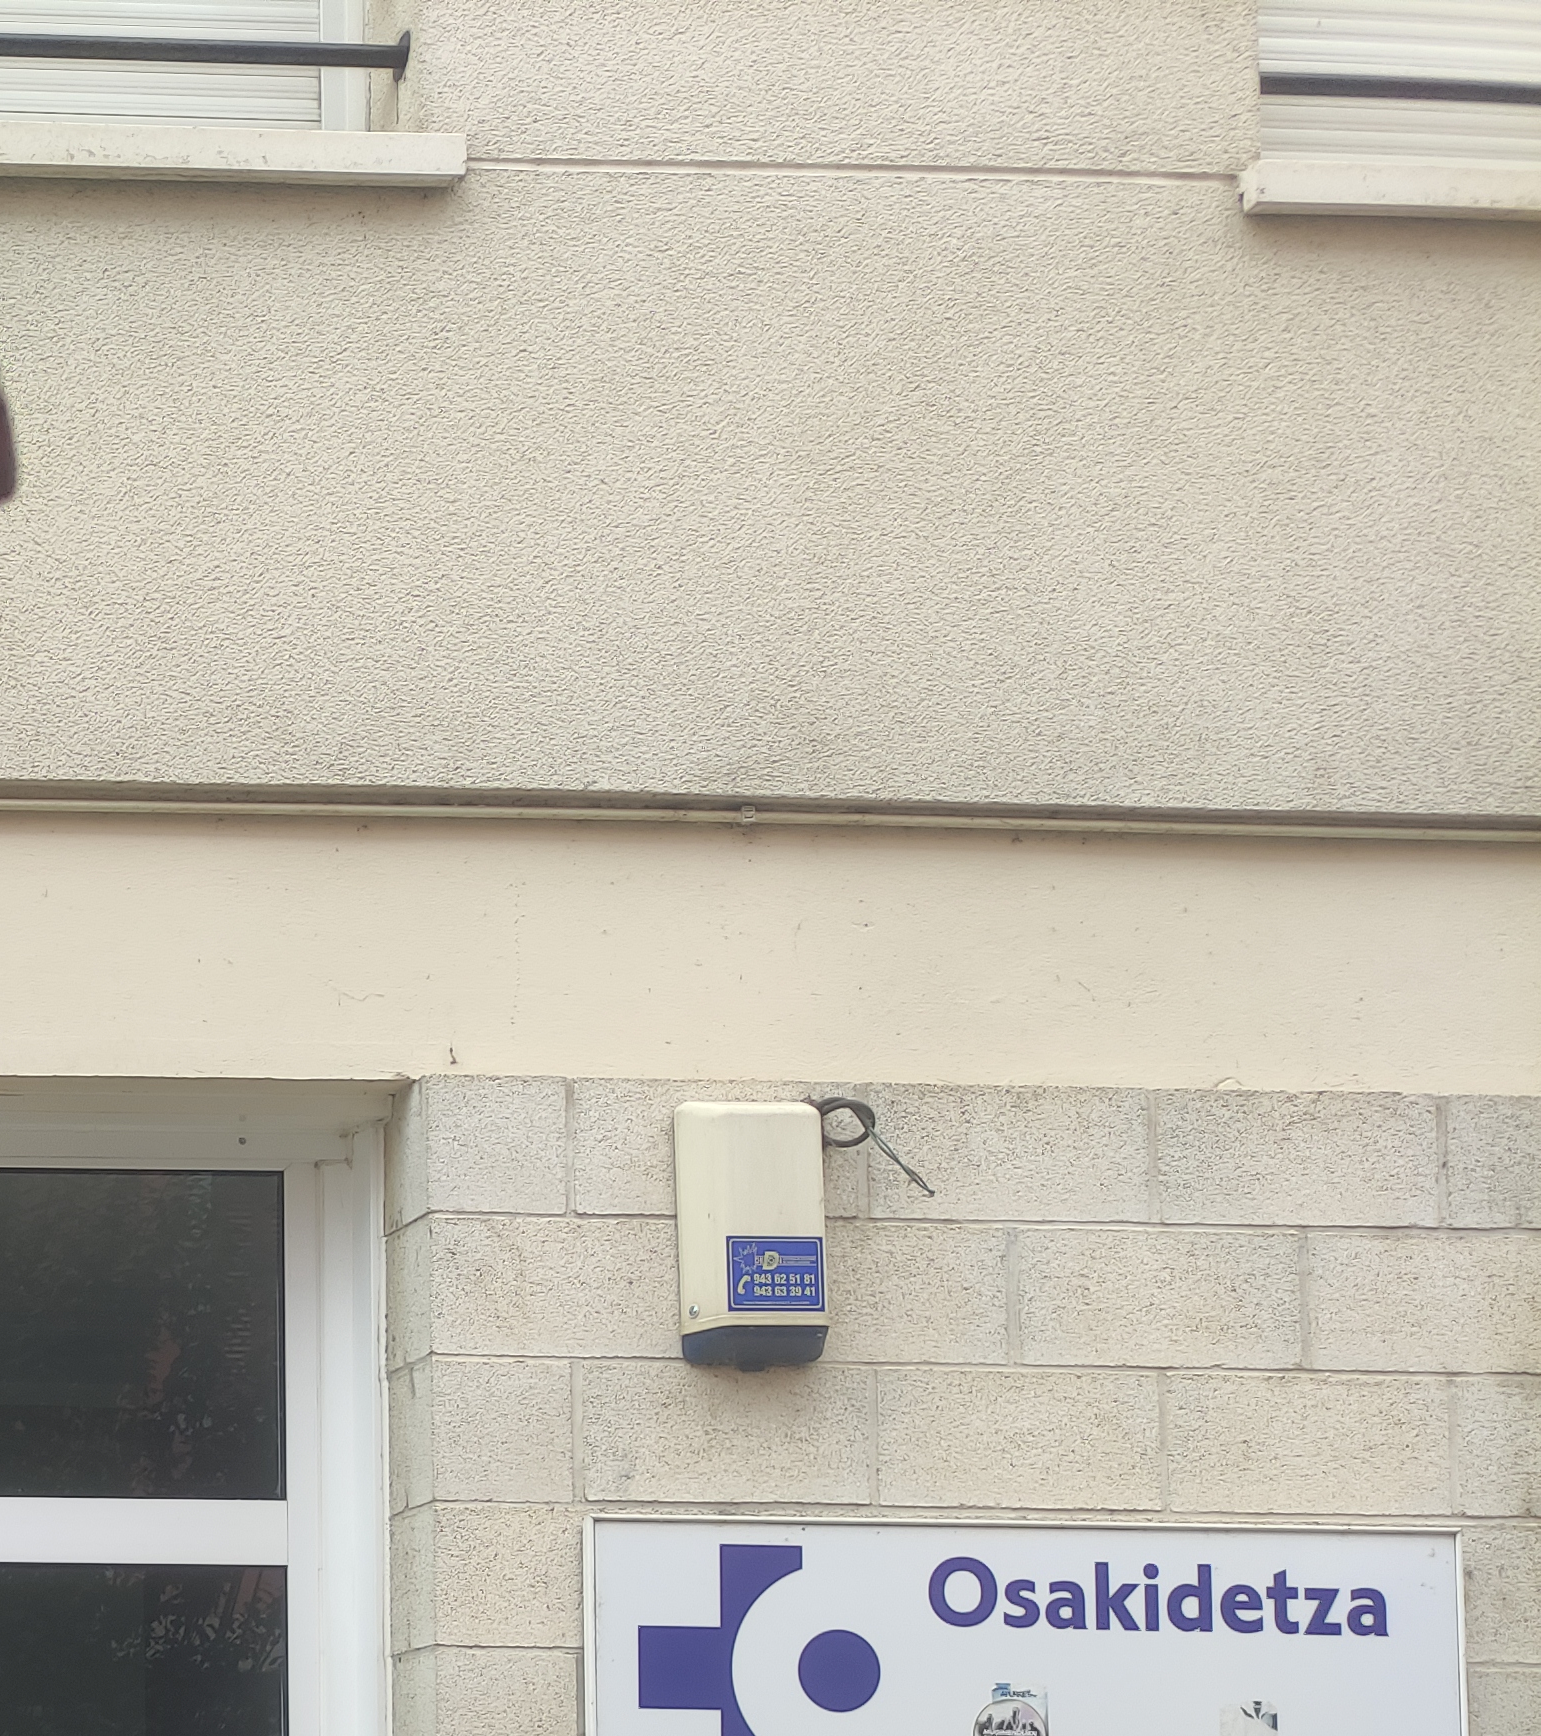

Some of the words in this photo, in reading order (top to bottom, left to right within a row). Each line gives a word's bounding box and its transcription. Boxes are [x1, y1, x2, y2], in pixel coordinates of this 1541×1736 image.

[754, 1273, 772, 1284] 943
[774, 1274, 787, 1284] 62
[790, 1274, 801, 1284] 51
[804, 1274, 815, 1284] 81
[754, 1286, 772, 1296] 943
[804, 1286, 815, 1296] 41
[927, 1555, 1390, 1638] Osakidetza
